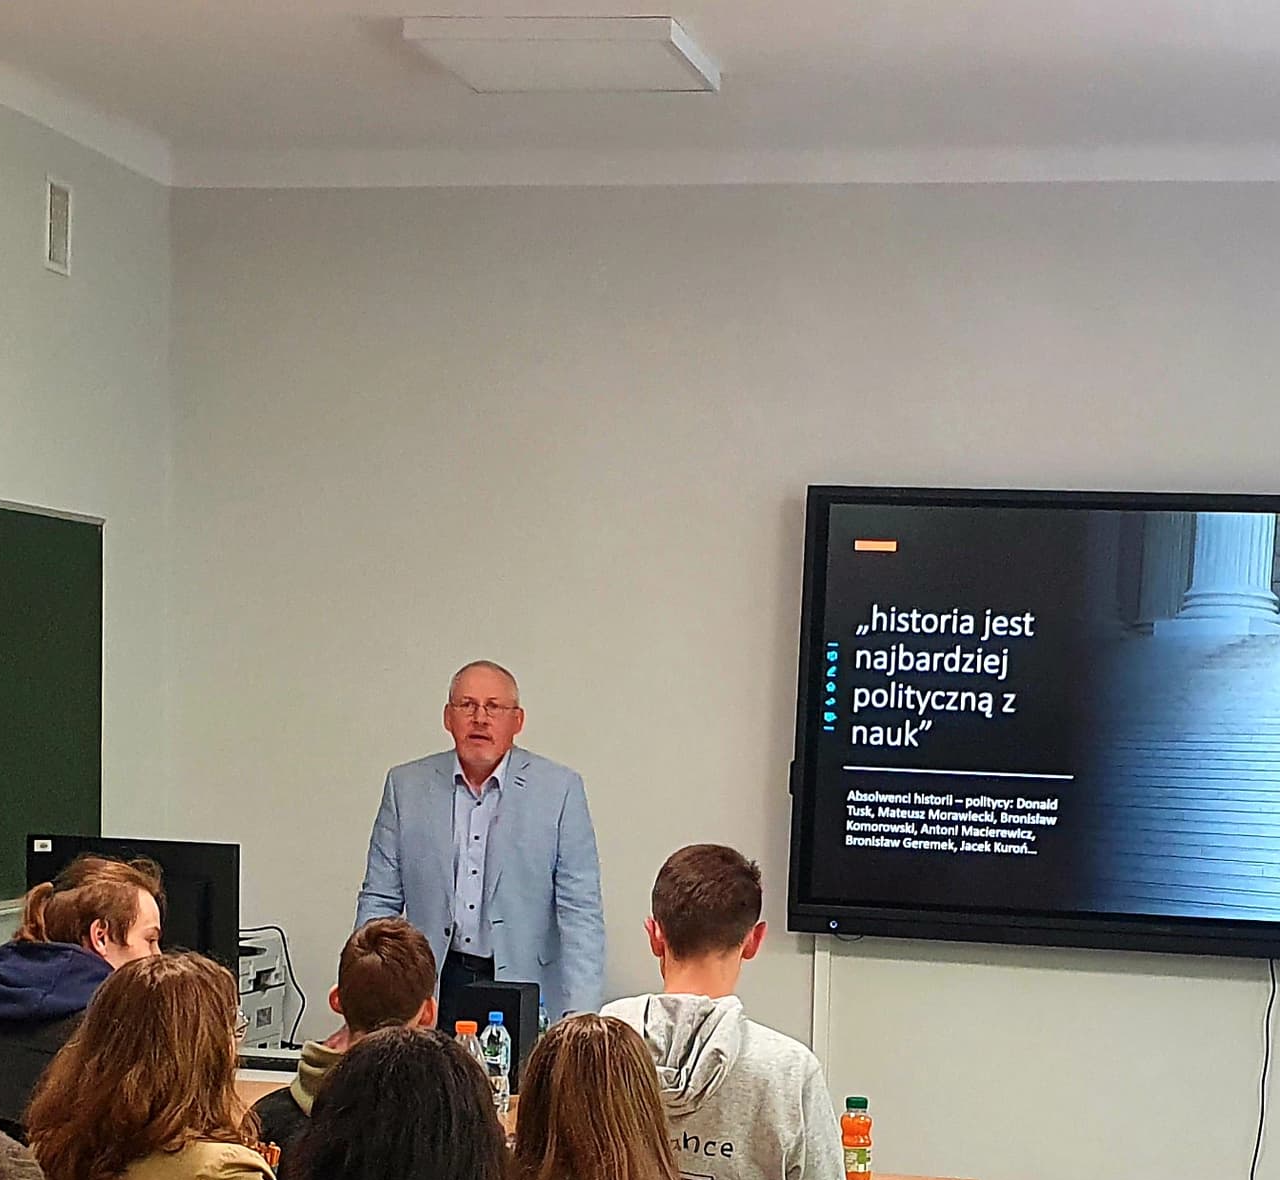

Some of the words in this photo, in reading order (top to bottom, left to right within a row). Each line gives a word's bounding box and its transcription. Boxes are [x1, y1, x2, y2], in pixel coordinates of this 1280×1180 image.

[855, 604, 975, 636] „historia
[980, 609, 1036, 641] jest
[855, 643, 1009, 680] najbardziej
[853, 682, 993, 718] polityczną
[1002, 692, 1017, 713] z
[846, 790, 912, 805] Absolwenci
[913, 793, 953, 806] historii
[965, 795, 1014, 811] politycy:
[1016, 798, 1059, 811] Donald
[846, 805, 875, 818] Tusk,
[877, 807, 926, 820] Mateusz
[928, 809, 998, 824] Morawiecki,
[1000, 812, 1058, 826] Bronisław
[846, 820, 918, 836] Komorowski,
[920, 823, 959, 836] Antoni
[961, 826, 1037, 841] Macierewicz,
[845, 834, 901, 848] Bronisław
[903, 837, 958, 852] Geremek,
[960, 840, 991, 853] Jacek
